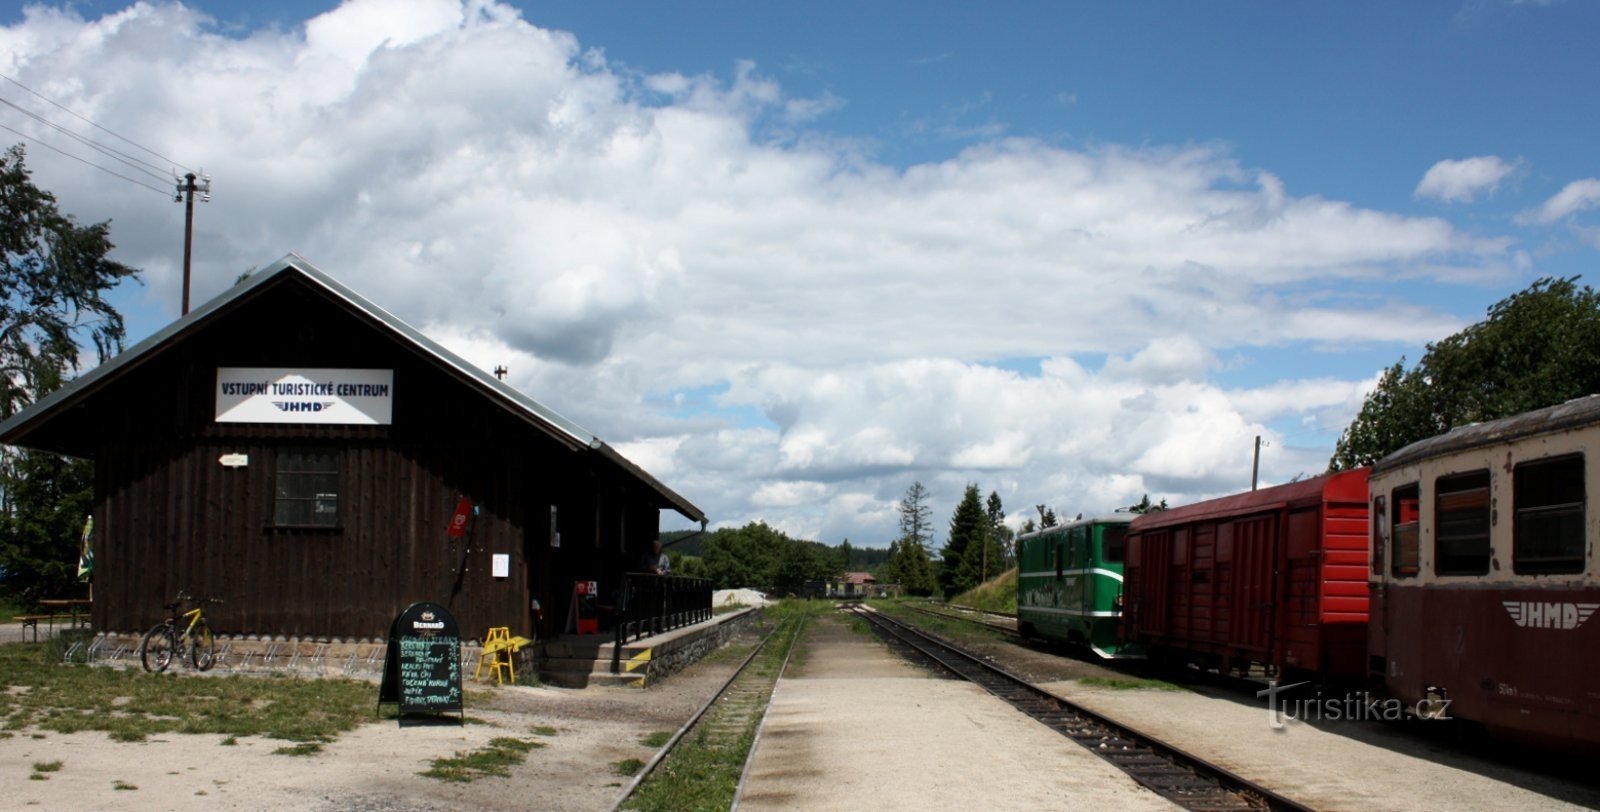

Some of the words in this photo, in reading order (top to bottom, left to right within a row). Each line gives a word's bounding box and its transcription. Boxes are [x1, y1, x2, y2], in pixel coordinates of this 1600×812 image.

[222, 381, 268, 395] VSTUPNÍ
[272, 381, 333, 396] TURISTICKÉ
[337, 384, 389, 397] CENTRUM
[282, 402, 323, 412] JHMD
[1516, 602, 1579, 630] JHMD
